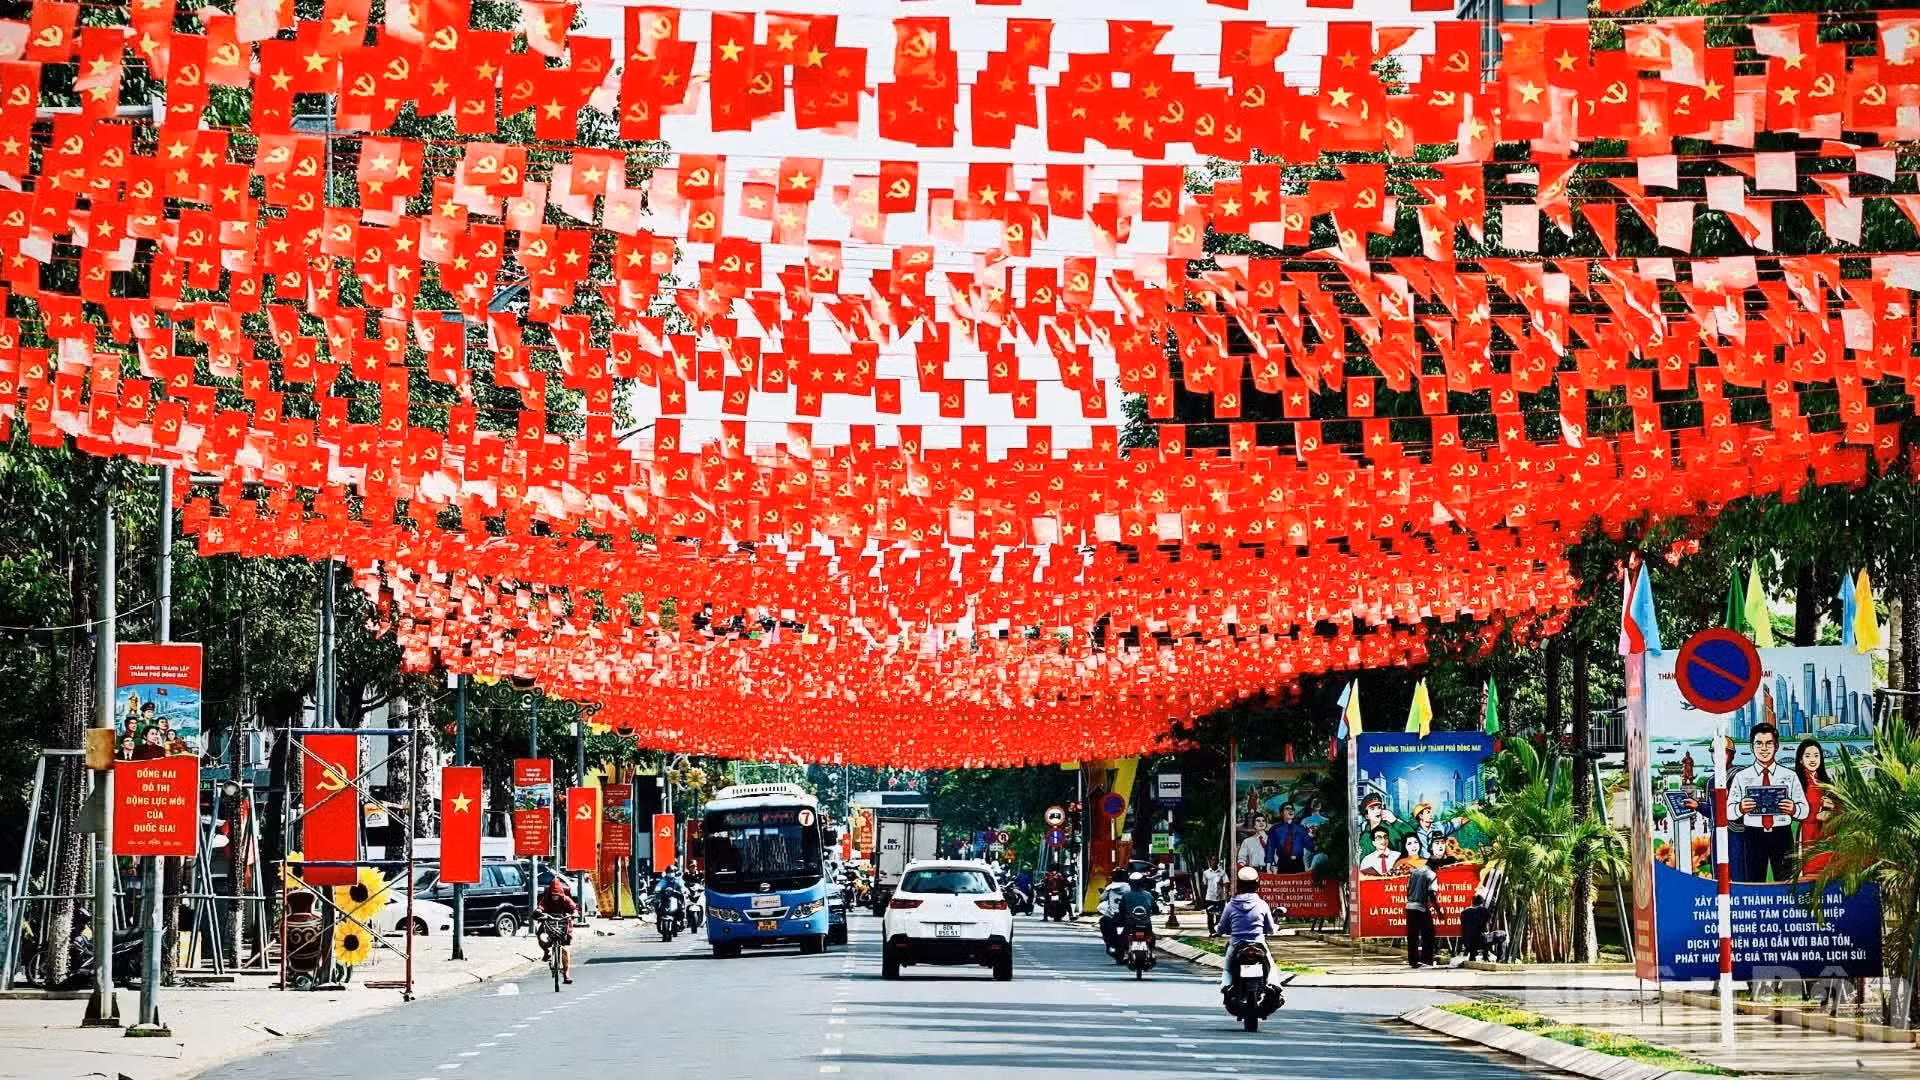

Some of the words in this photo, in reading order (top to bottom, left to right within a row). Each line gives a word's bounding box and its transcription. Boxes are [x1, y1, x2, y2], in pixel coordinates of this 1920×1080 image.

[137, 768, 160, 778] ĐỒNG
[162, 770, 176, 778] NAI
[126, 795, 149, 806] ĐỘNG
[146, 808, 164, 819] CỦA
[801, 812, 810, 825] 7
[134, 822, 157, 833] QUỐC
[1384, 883, 1398, 892] XÂY
[1437, 882, 1450, 891] HÁT
[1694, 894, 1712, 906] XÂY
[1742, 894, 1773, 906] THÀNH
[1826, 894, 1842, 904] NAI
[1760, 908, 1779, 919] TÂM
[1782, 908, 1808, 919] CÔNG
[1733, 922, 1757, 934] NGHỆ
[1760, 923, 1782, 934] CAO,
[1784, 922, 1835, 933] LOGISTICS;
[1688, 940, 1710, 951] DỊCH
[1752, 937, 1768, 950] ĐẠI
[1771, 934, 1789, 947] GẮN
[1792, 934, 1808, 946] VỚI
[1810, 934, 1830, 946] BẢO
[1832, 933, 1854, 947] TỒN,
[1675, 952, 1699, 964] PHÁT
[1702, 954, 1720, 963] HUY
[1745, 950, 1760, 962] GIÁ
[1763, 952, 1778, 963] TRỊ
[1802, 950, 1824, 962] HÓA,
[1826, 951, 1848, 963] LỊCH
[1851, 948, 1866, 960] SỬ!
